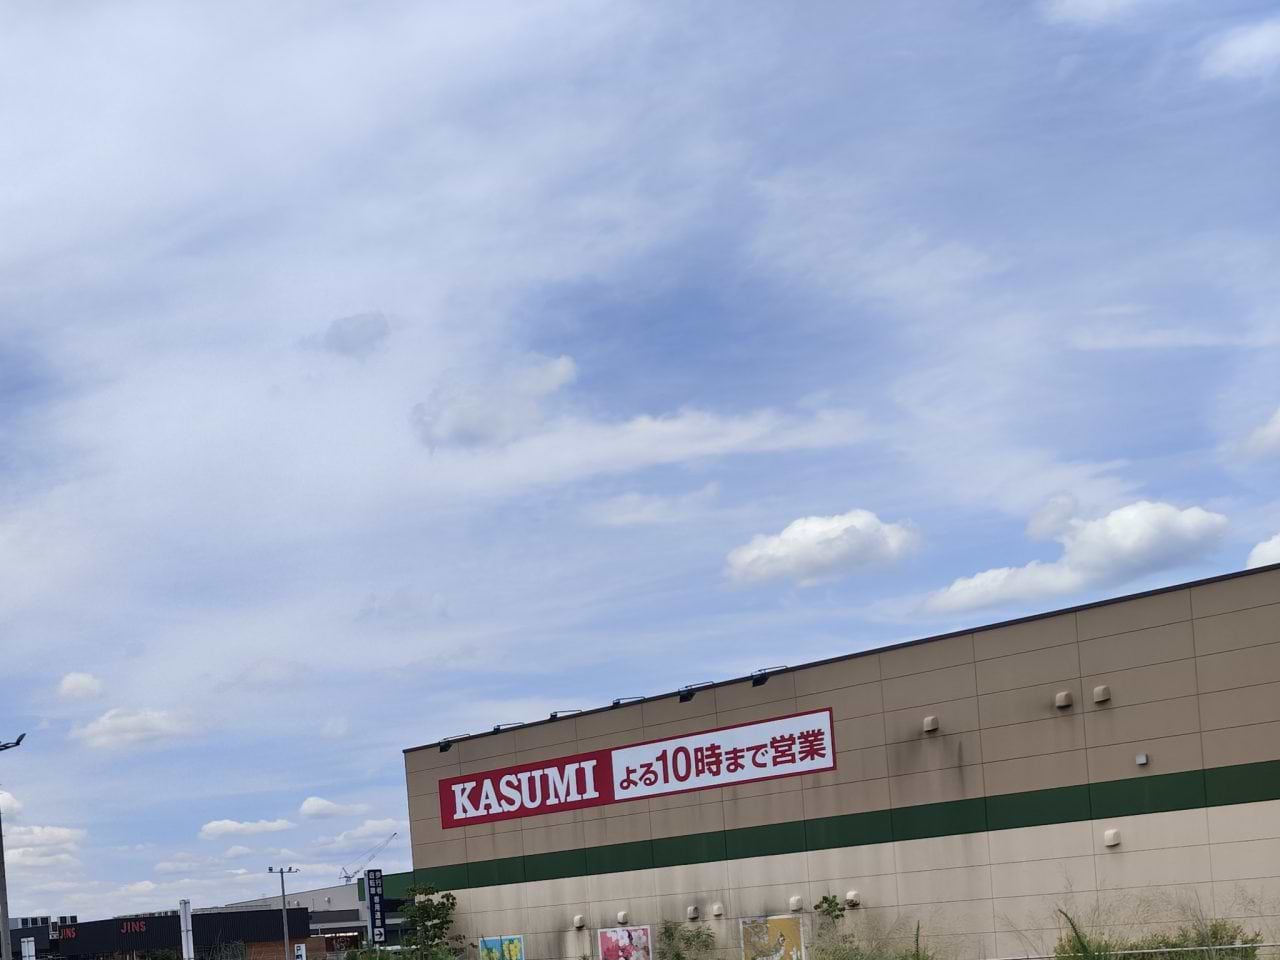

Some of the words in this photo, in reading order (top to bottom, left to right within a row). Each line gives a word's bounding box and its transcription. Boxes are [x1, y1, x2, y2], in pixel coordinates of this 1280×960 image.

[451, 759, 600, 819] KASUMI
[618, 728, 827, 791] よる10時まで営業
[121, 921, 146, 934] JINS
